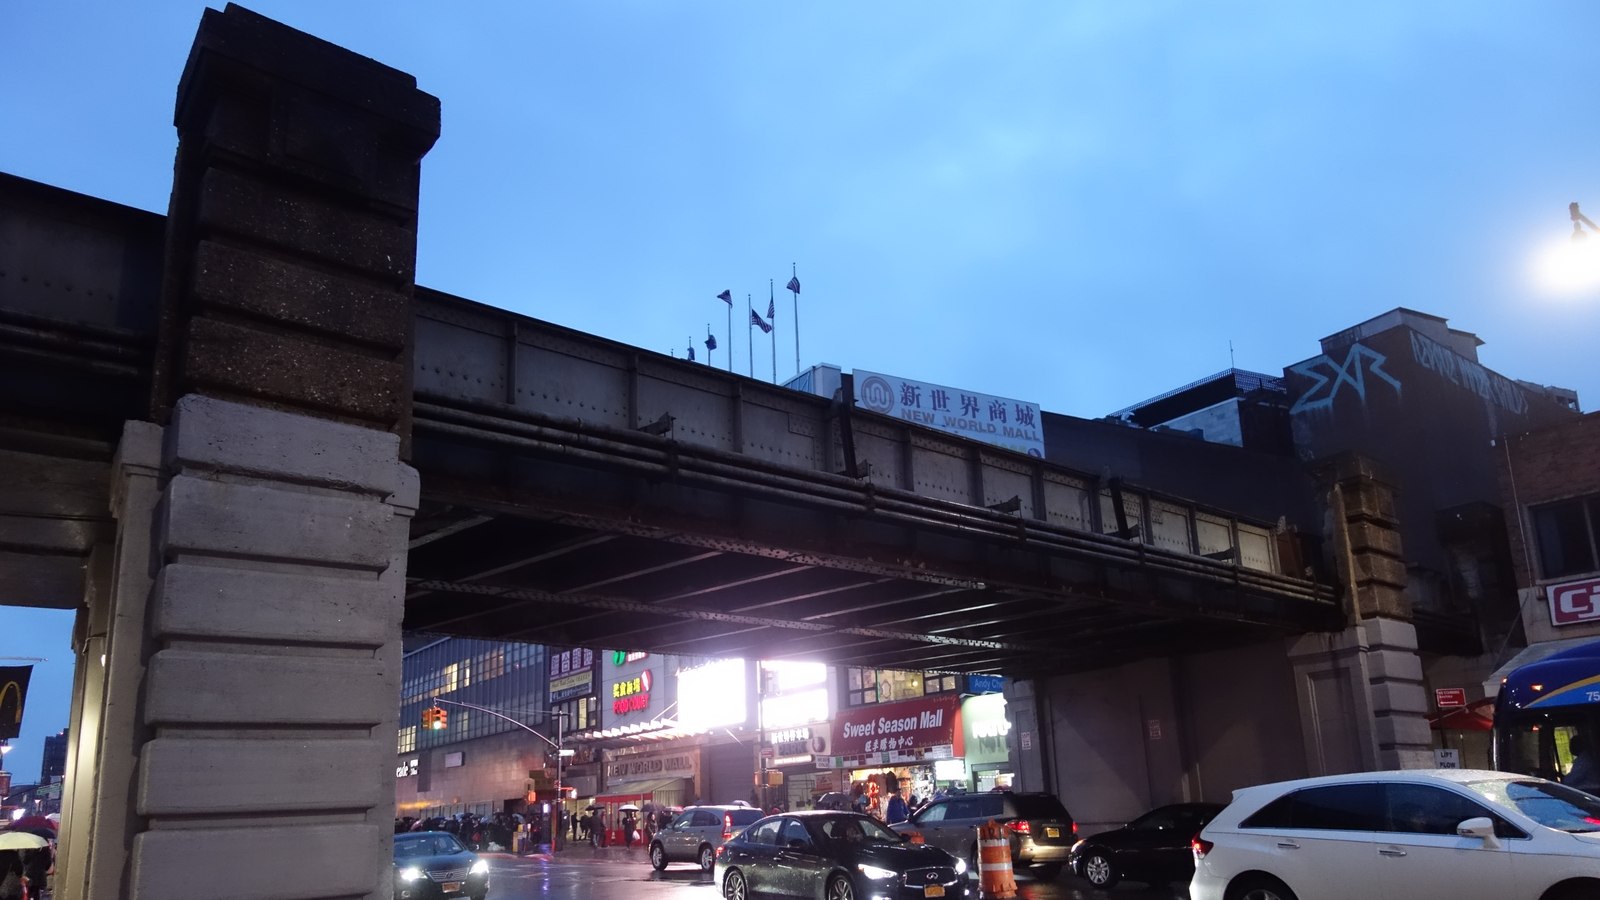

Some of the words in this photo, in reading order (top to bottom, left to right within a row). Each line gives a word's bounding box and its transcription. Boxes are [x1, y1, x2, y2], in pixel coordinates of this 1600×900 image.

[901, 381, 1036, 429] 新世界商城
[901, 407, 935, 424] NEW
[944, 417, 997, 434] WORLD
[1003, 426, 1041, 442] MALL
[974, 679, 991, 690] Andy
[843, 719, 876, 739] Sweet
[878, 716, 918, 735] Season
[920, 708, 943, 730] Mall
[606, 763, 629, 778] NEW
[630, 759, 662, 775] WORLD
[663, 755, 693, 771] MALL
